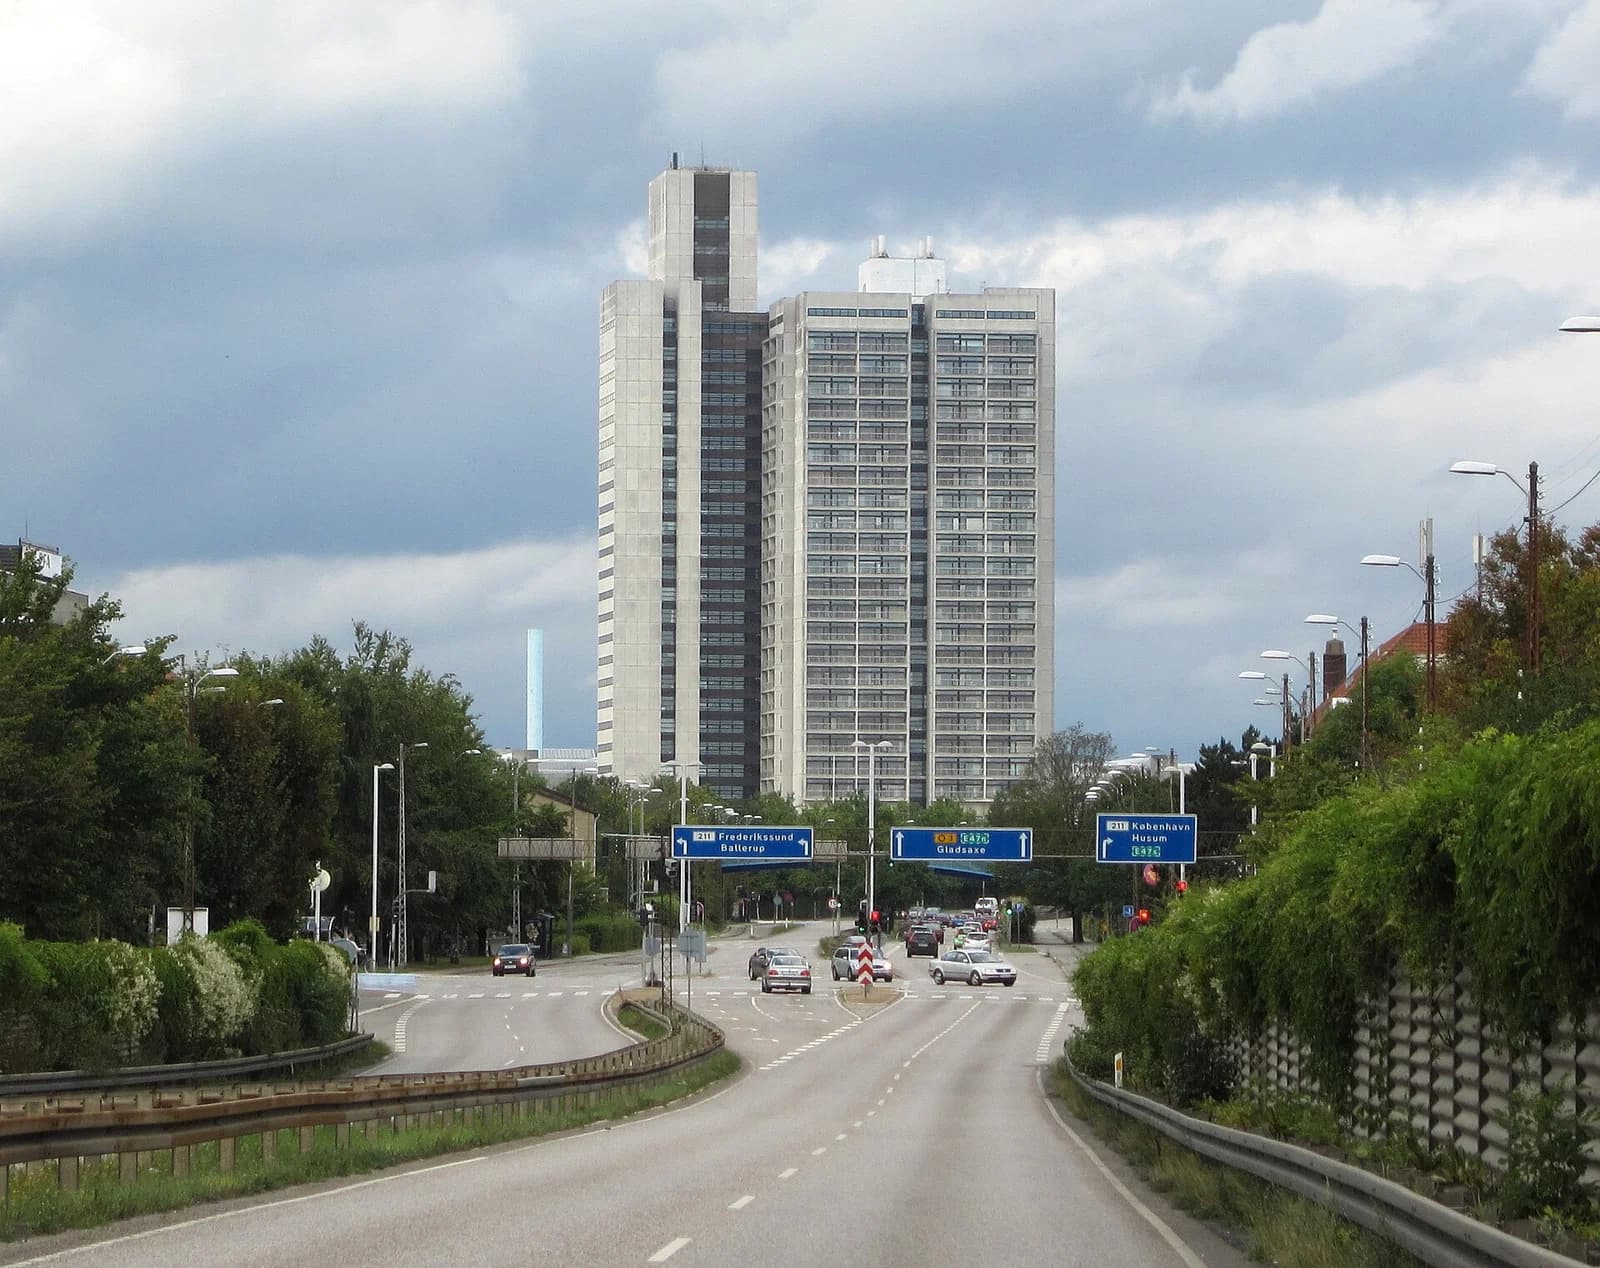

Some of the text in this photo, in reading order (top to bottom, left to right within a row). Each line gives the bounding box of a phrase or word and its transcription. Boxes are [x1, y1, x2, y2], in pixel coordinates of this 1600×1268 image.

[1111, 822, 1190, 831] 211 København
[697, 832, 794, 841] 211 Frederikssund
[1132, 834, 1167, 842] Husum
[721, 843, 765, 853] Ballerup
[937, 845, 986, 854] Gladsaxe
